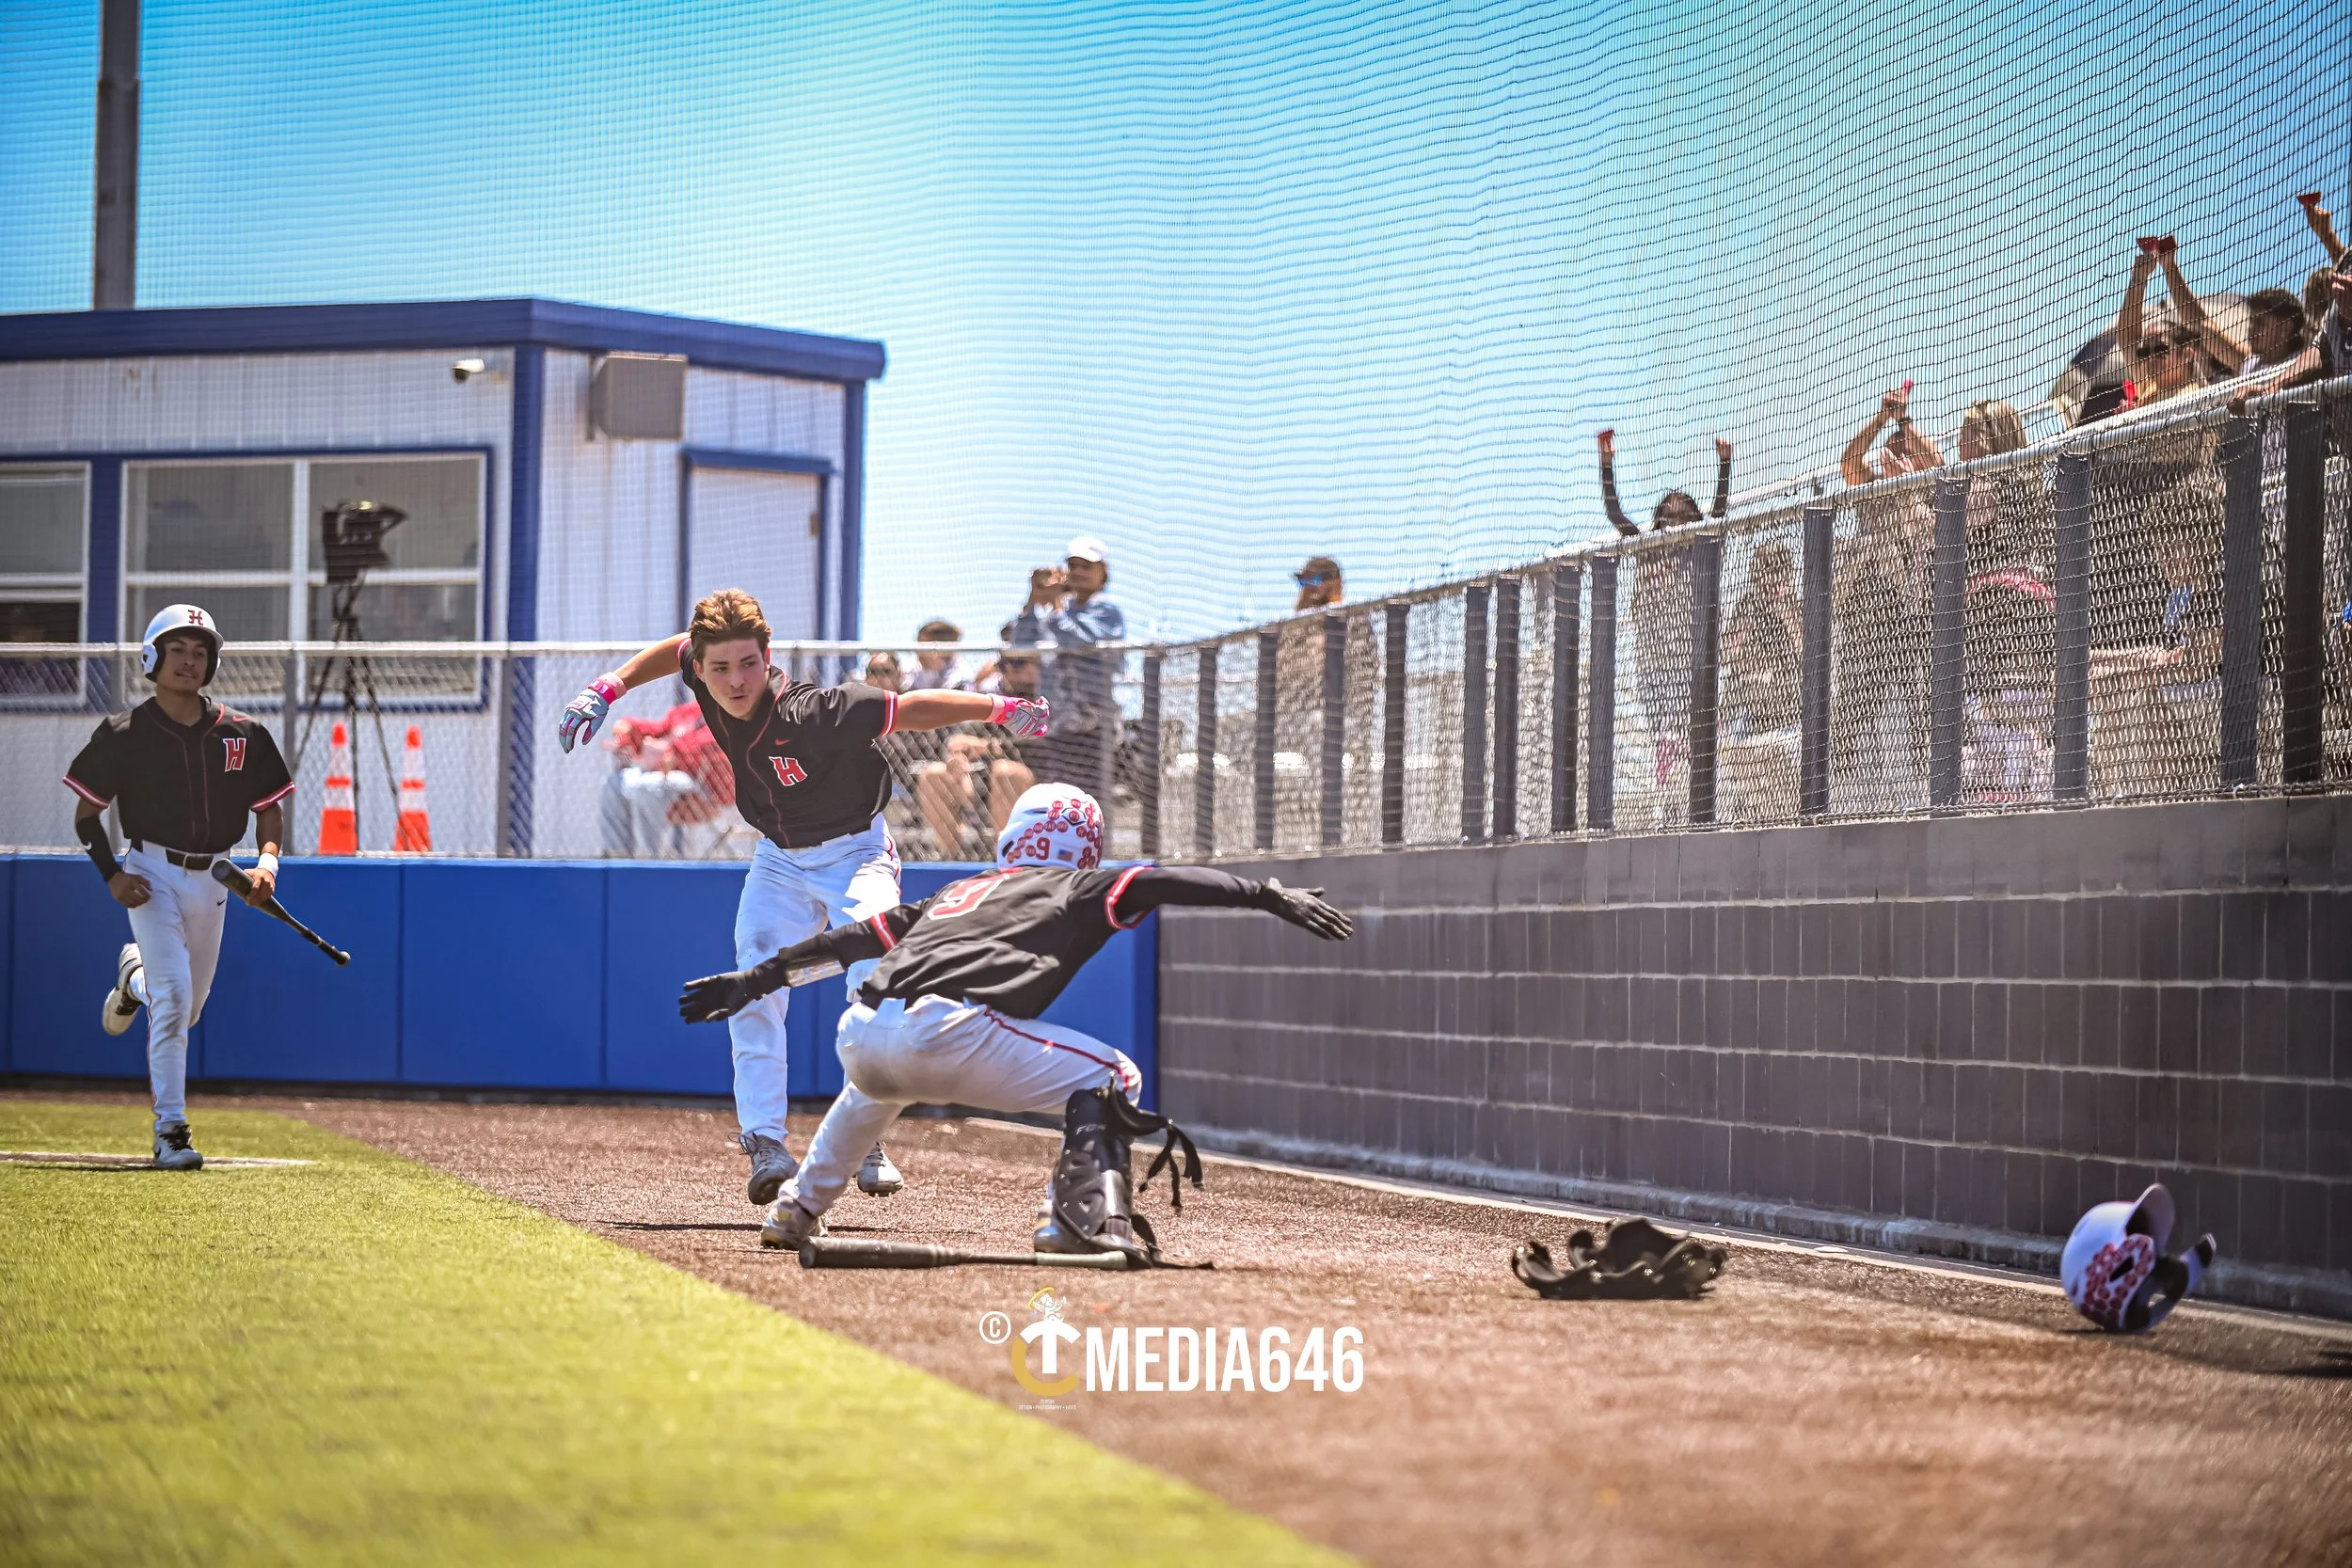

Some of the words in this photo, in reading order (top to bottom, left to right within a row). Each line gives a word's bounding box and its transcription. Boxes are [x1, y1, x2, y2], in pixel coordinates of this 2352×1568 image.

[187, 609, 204, 626] H
[222, 737, 247, 772] H
[768, 755, 808, 787] H
[1036, 836, 1051, 861] 9
